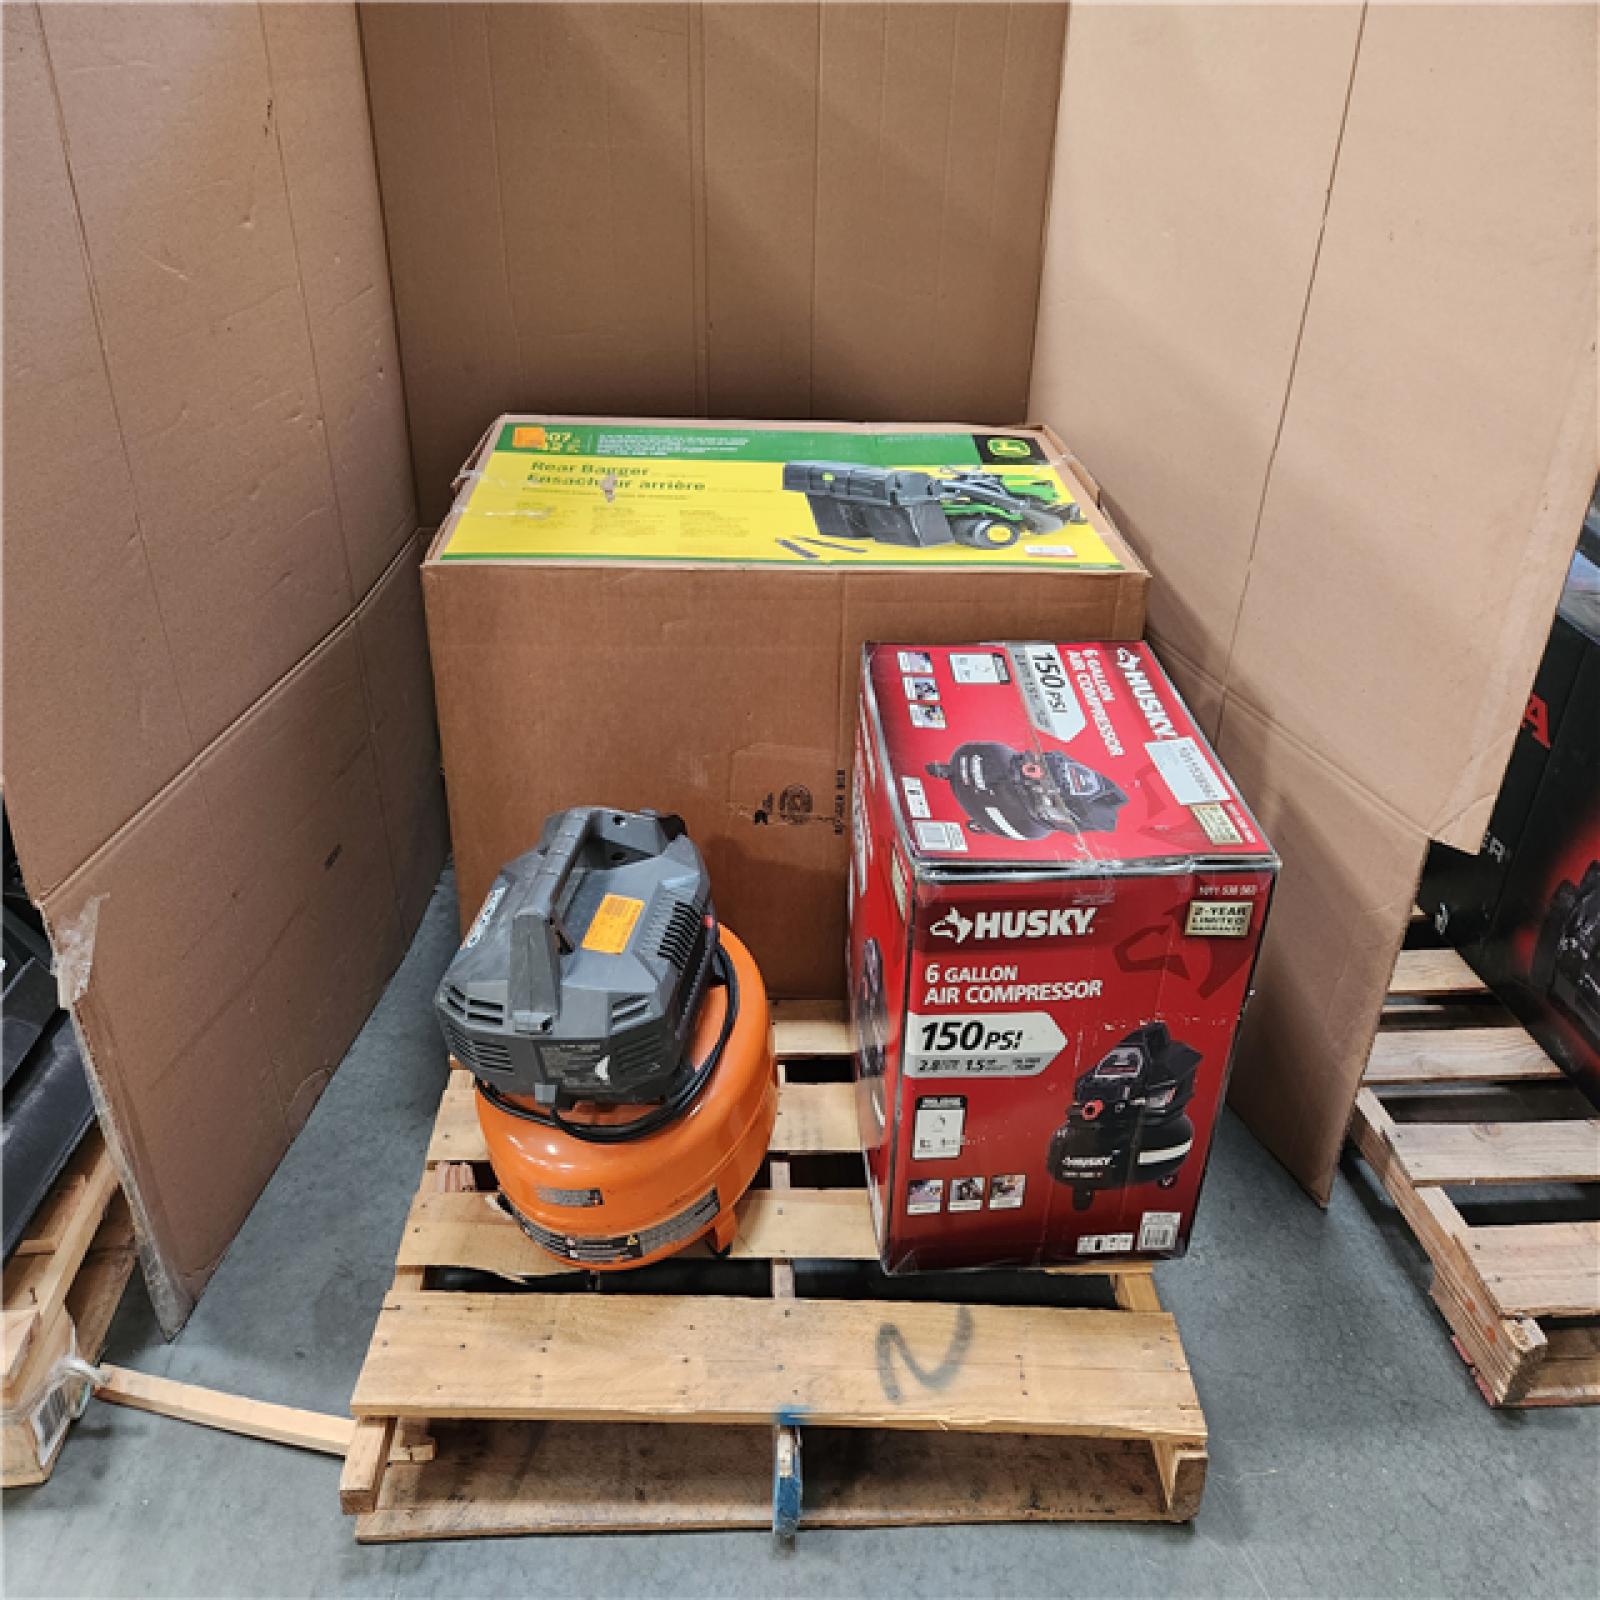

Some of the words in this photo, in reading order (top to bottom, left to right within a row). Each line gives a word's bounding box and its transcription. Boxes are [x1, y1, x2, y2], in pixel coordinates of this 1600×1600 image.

[527, 474, 633, 490] Ensachur
[531, 461, 575, 473] Rear
[581, 463, 650, 477] Bagger
[1032, 652, 1066, 689] 150
[1077, 673, 1126, 756] COMPRESSOR
[1124, 671, 1179, 738] HUSKY
[974, 907, 1095, 940] HUSKY
[925, 964, 939, 983] 6
[945, 965, 1018, 983] GALLON
[924, 985, 959, 1005] AIR
[965, 979, 1103, 1004] COMPRESSOR
[921, 1020, 984, 1051] 150
